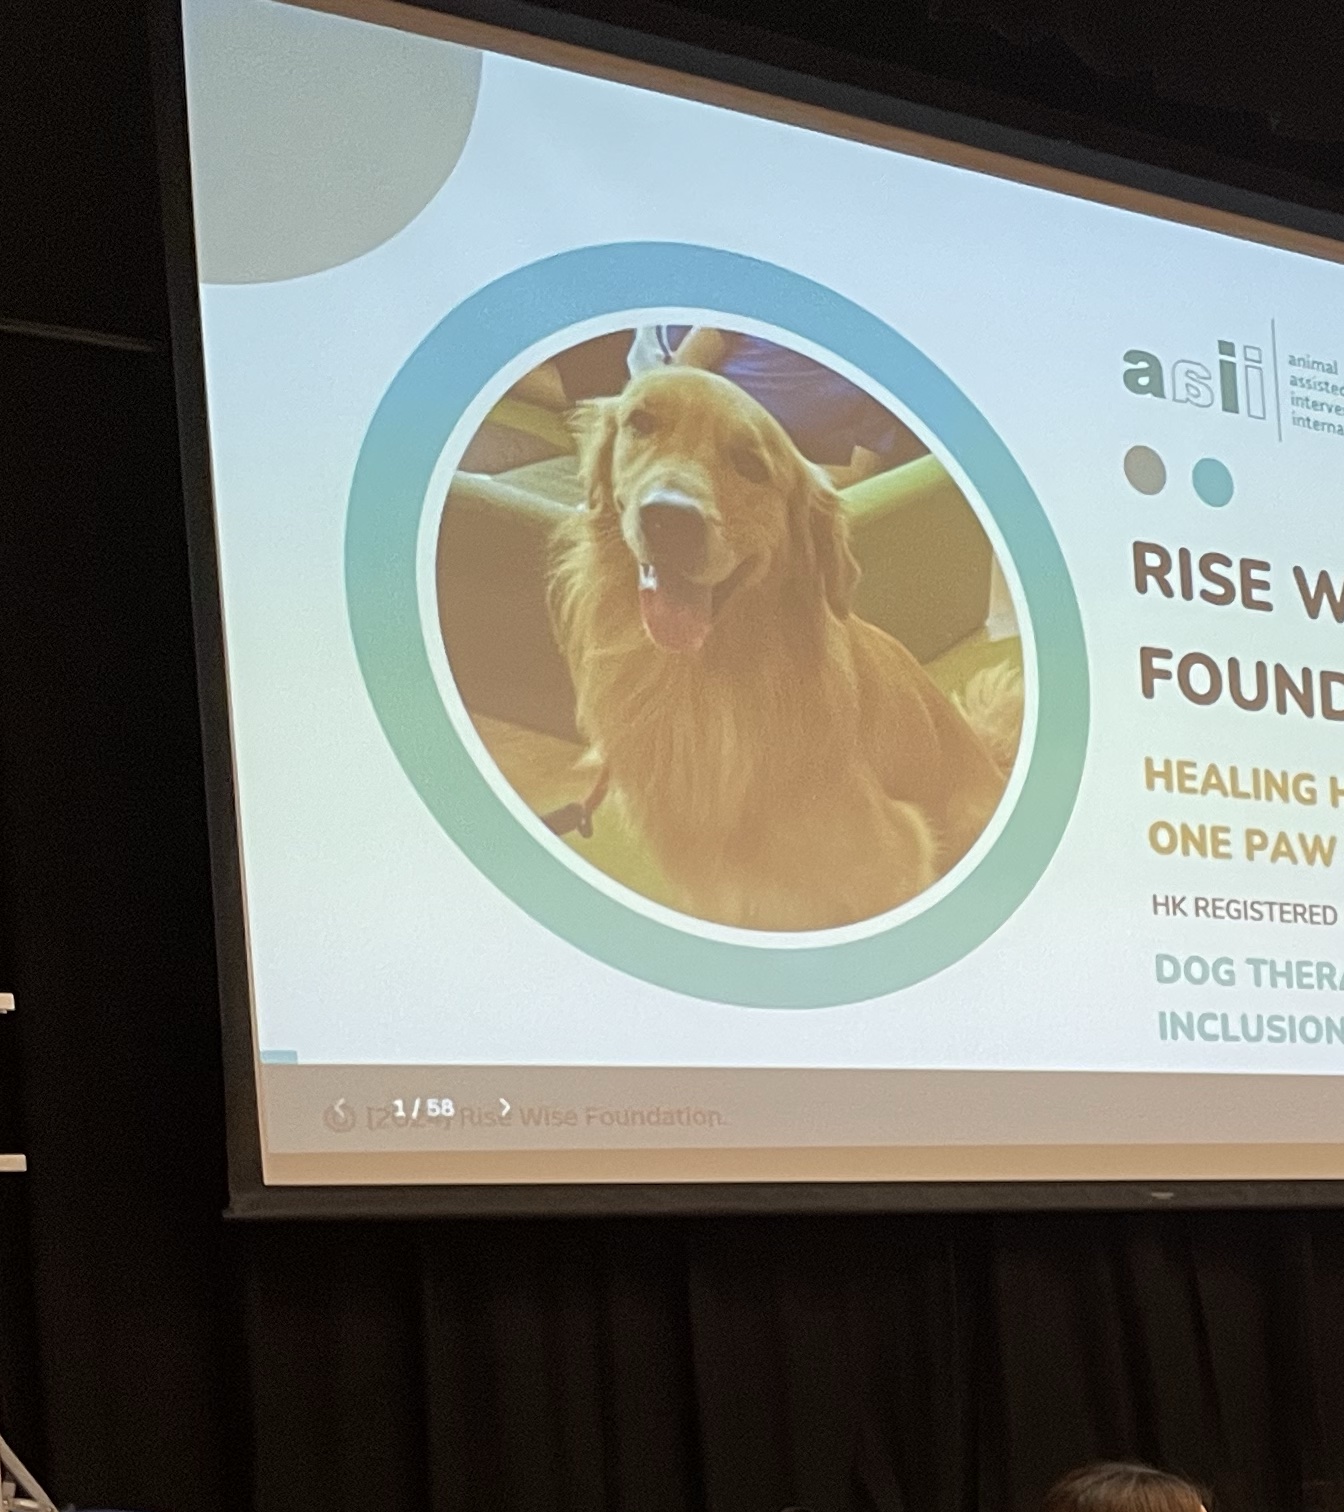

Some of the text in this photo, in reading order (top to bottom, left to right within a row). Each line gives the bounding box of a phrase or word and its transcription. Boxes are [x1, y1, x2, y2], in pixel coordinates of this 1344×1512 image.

[1288, 354, 1338, 375] animal
[1132, 540, 1274, 612] RISE
[1144, 757, 1317, 805] HEALING
[1148, 821, 1232, 860] ONE
[1245, 828, 1337, 869] PAW
[1152, 894, 1188, 917] HK
[1195, 897, 1338, 926] REGISTERED
[1155, 954, 1236, 987] DOG
[520, 1105, 578, 1127] Wise
